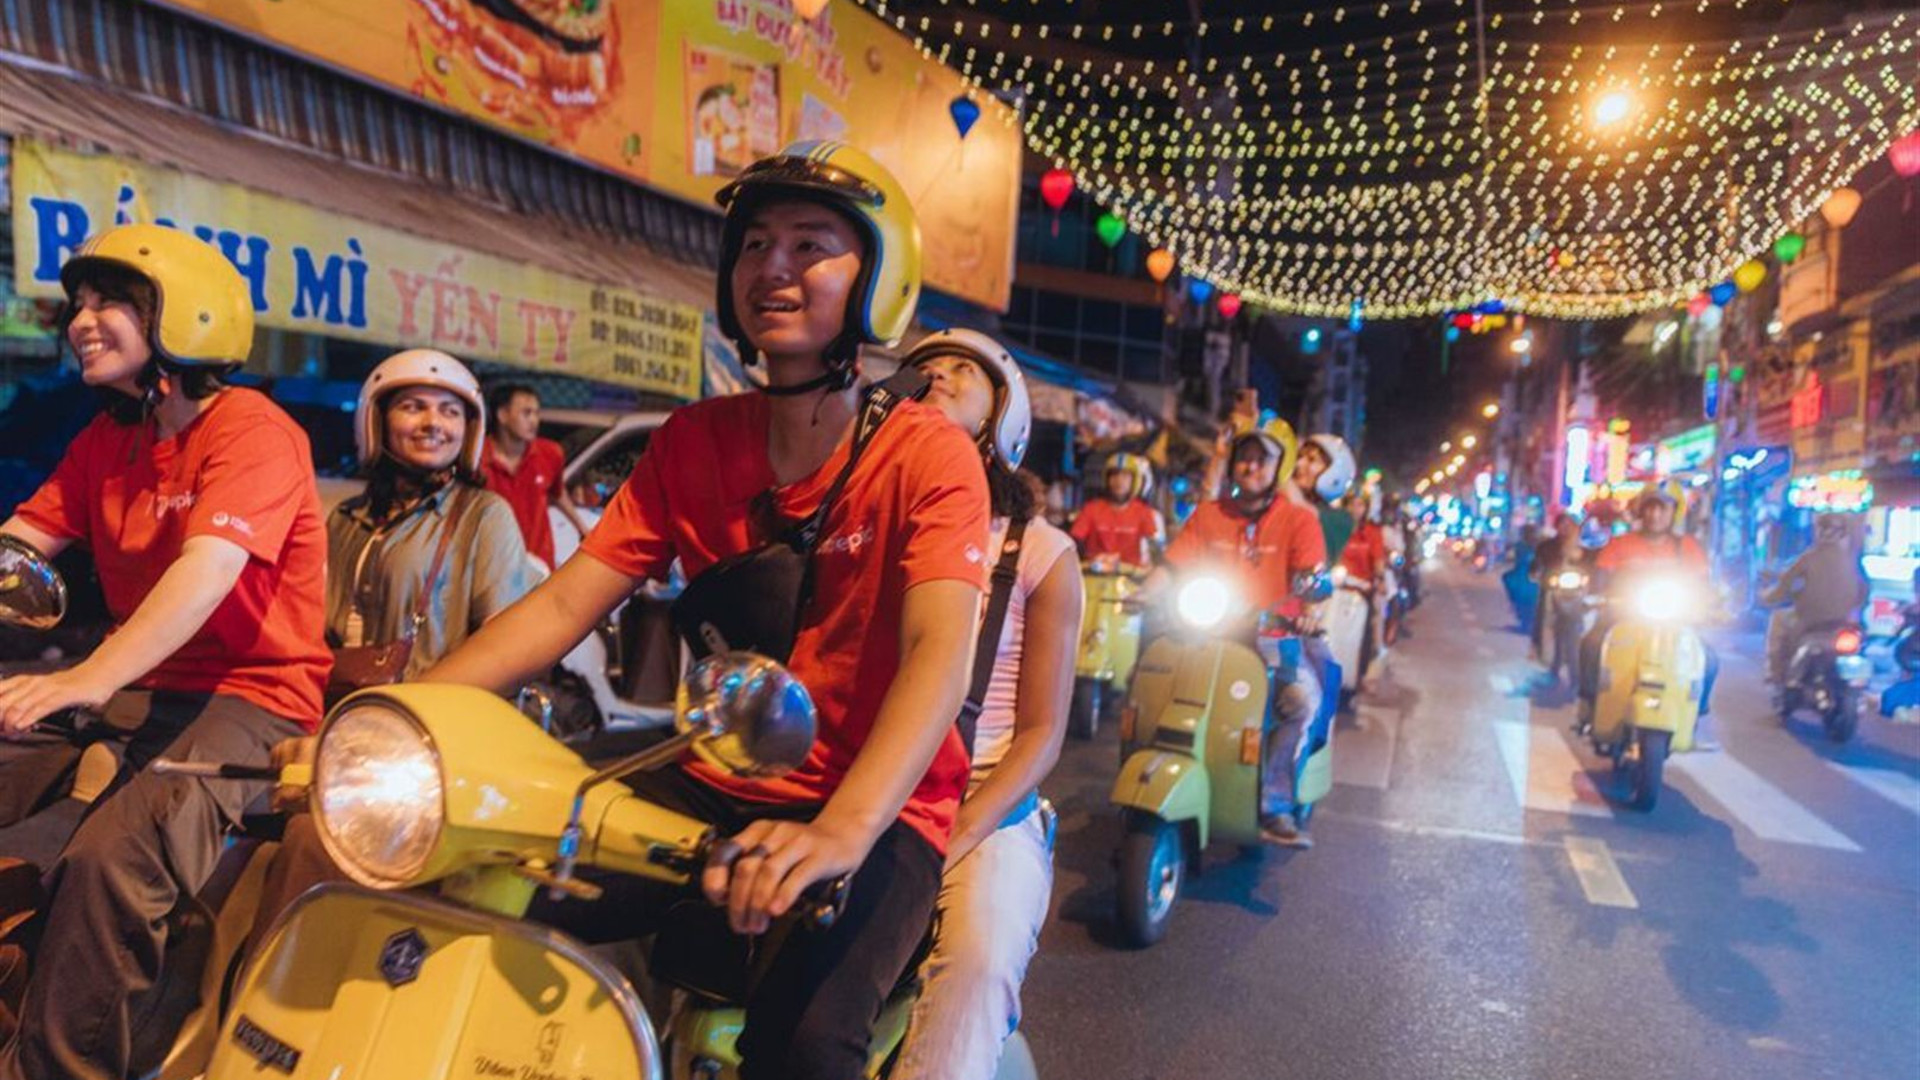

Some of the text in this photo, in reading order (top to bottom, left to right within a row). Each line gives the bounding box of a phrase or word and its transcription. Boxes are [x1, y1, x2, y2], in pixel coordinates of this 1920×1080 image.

[29, 184, 577, 364] BH MÌ YẾN TY
